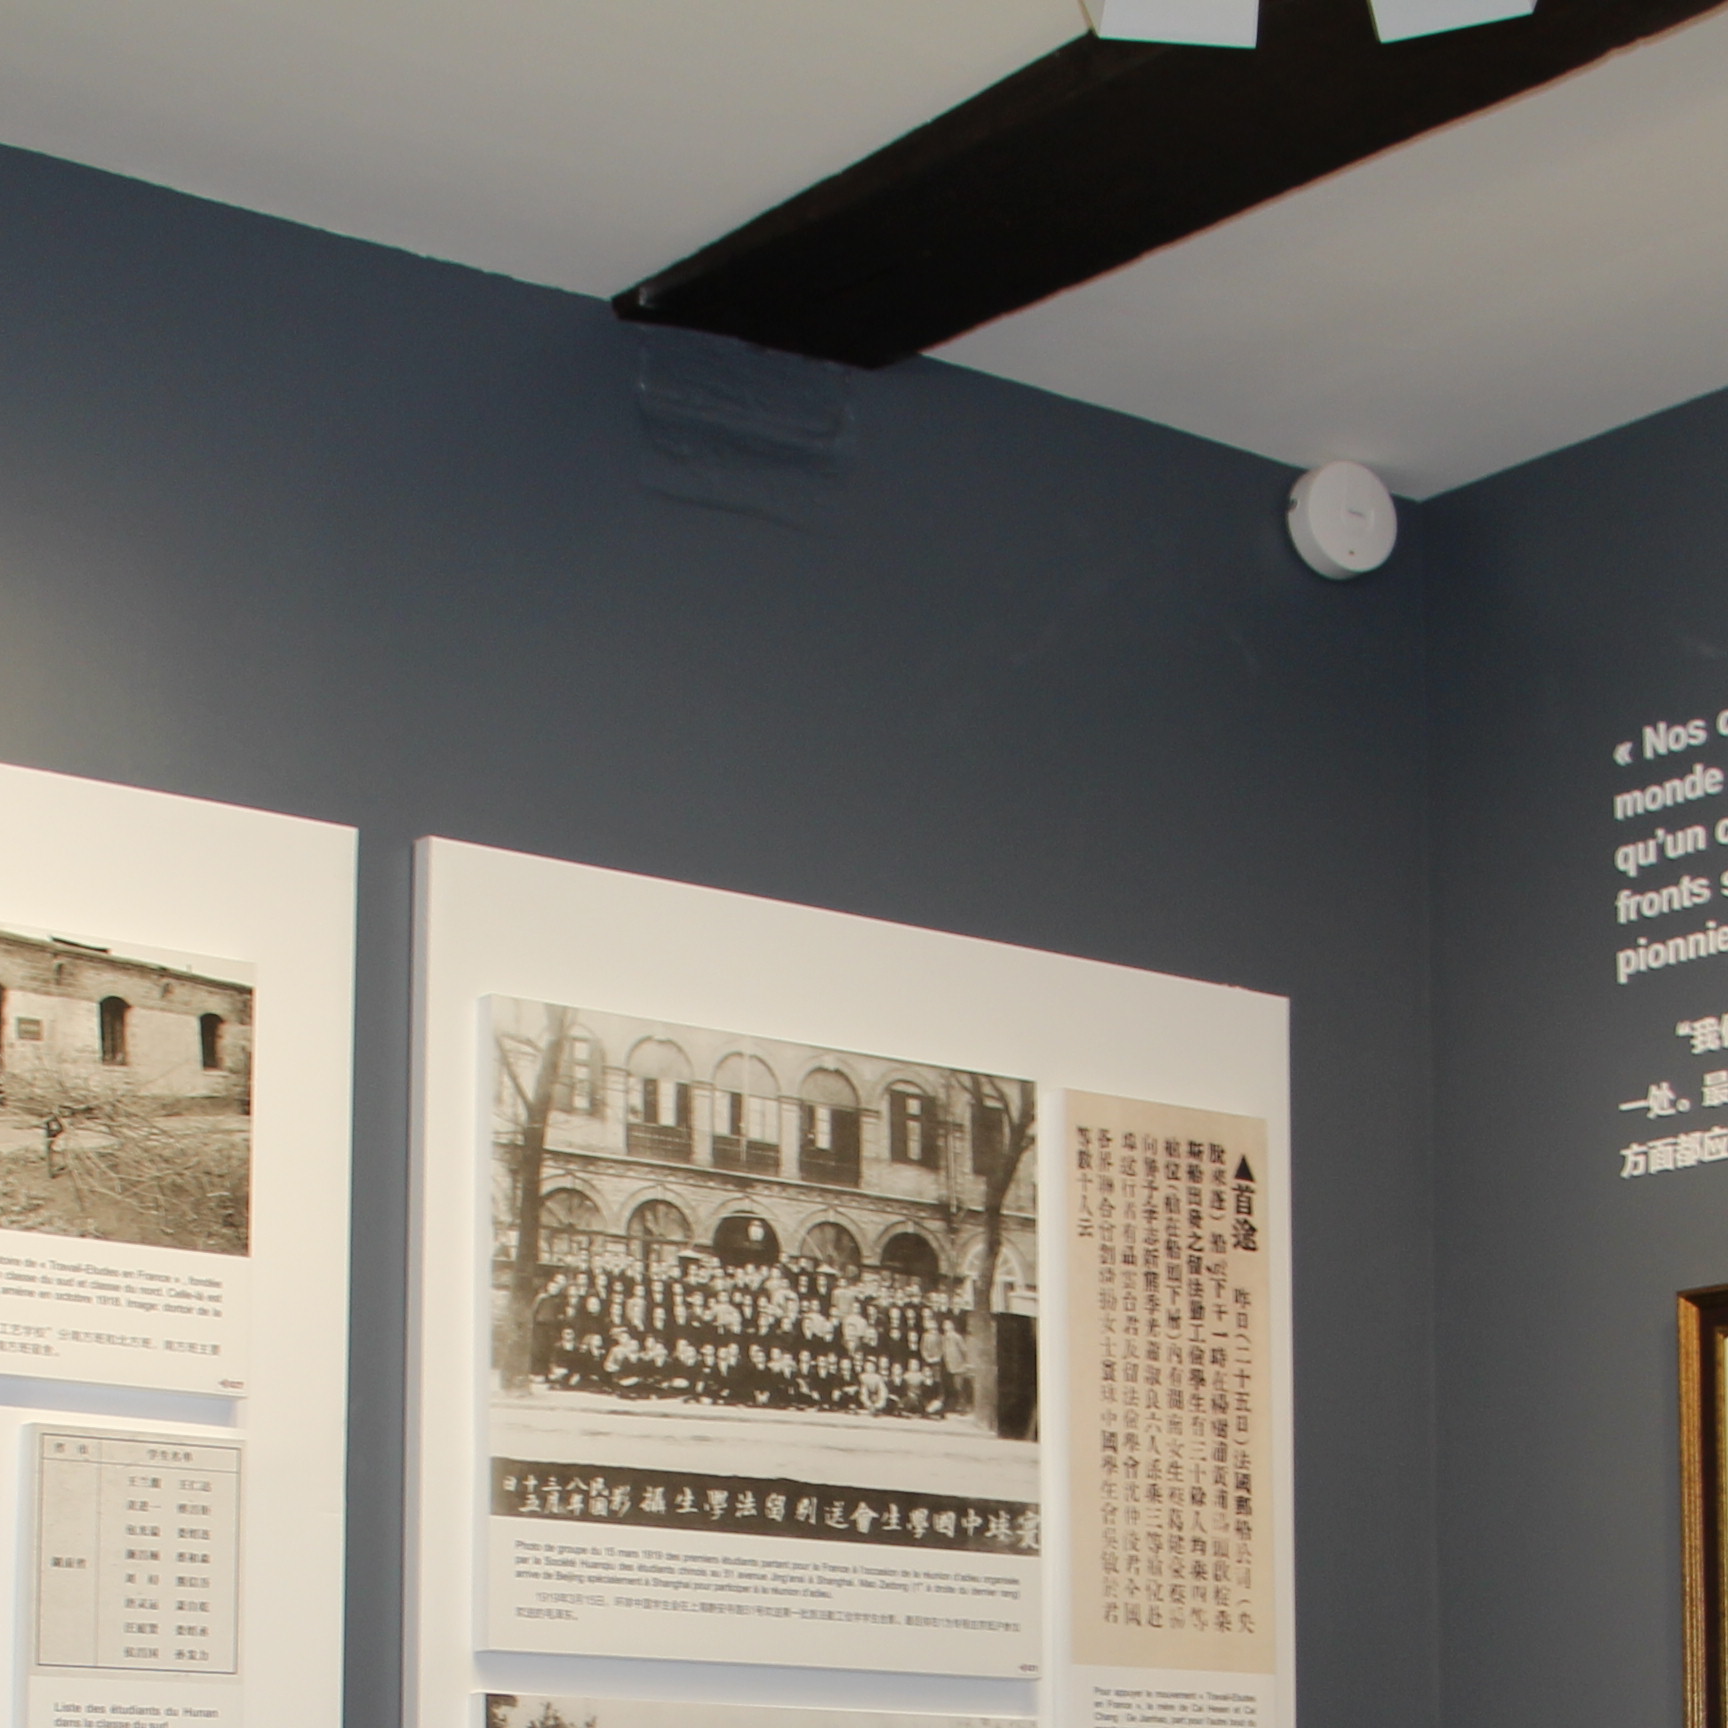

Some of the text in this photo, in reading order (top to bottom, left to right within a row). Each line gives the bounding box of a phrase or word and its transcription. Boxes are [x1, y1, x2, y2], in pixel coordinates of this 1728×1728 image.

[1642, 719, 1708, 760] Nos
[1613, 763, 1725, 821] monde
[1614, 825, 1707, 878] qu’un
[1614, 875, 1712, 925] fronts
